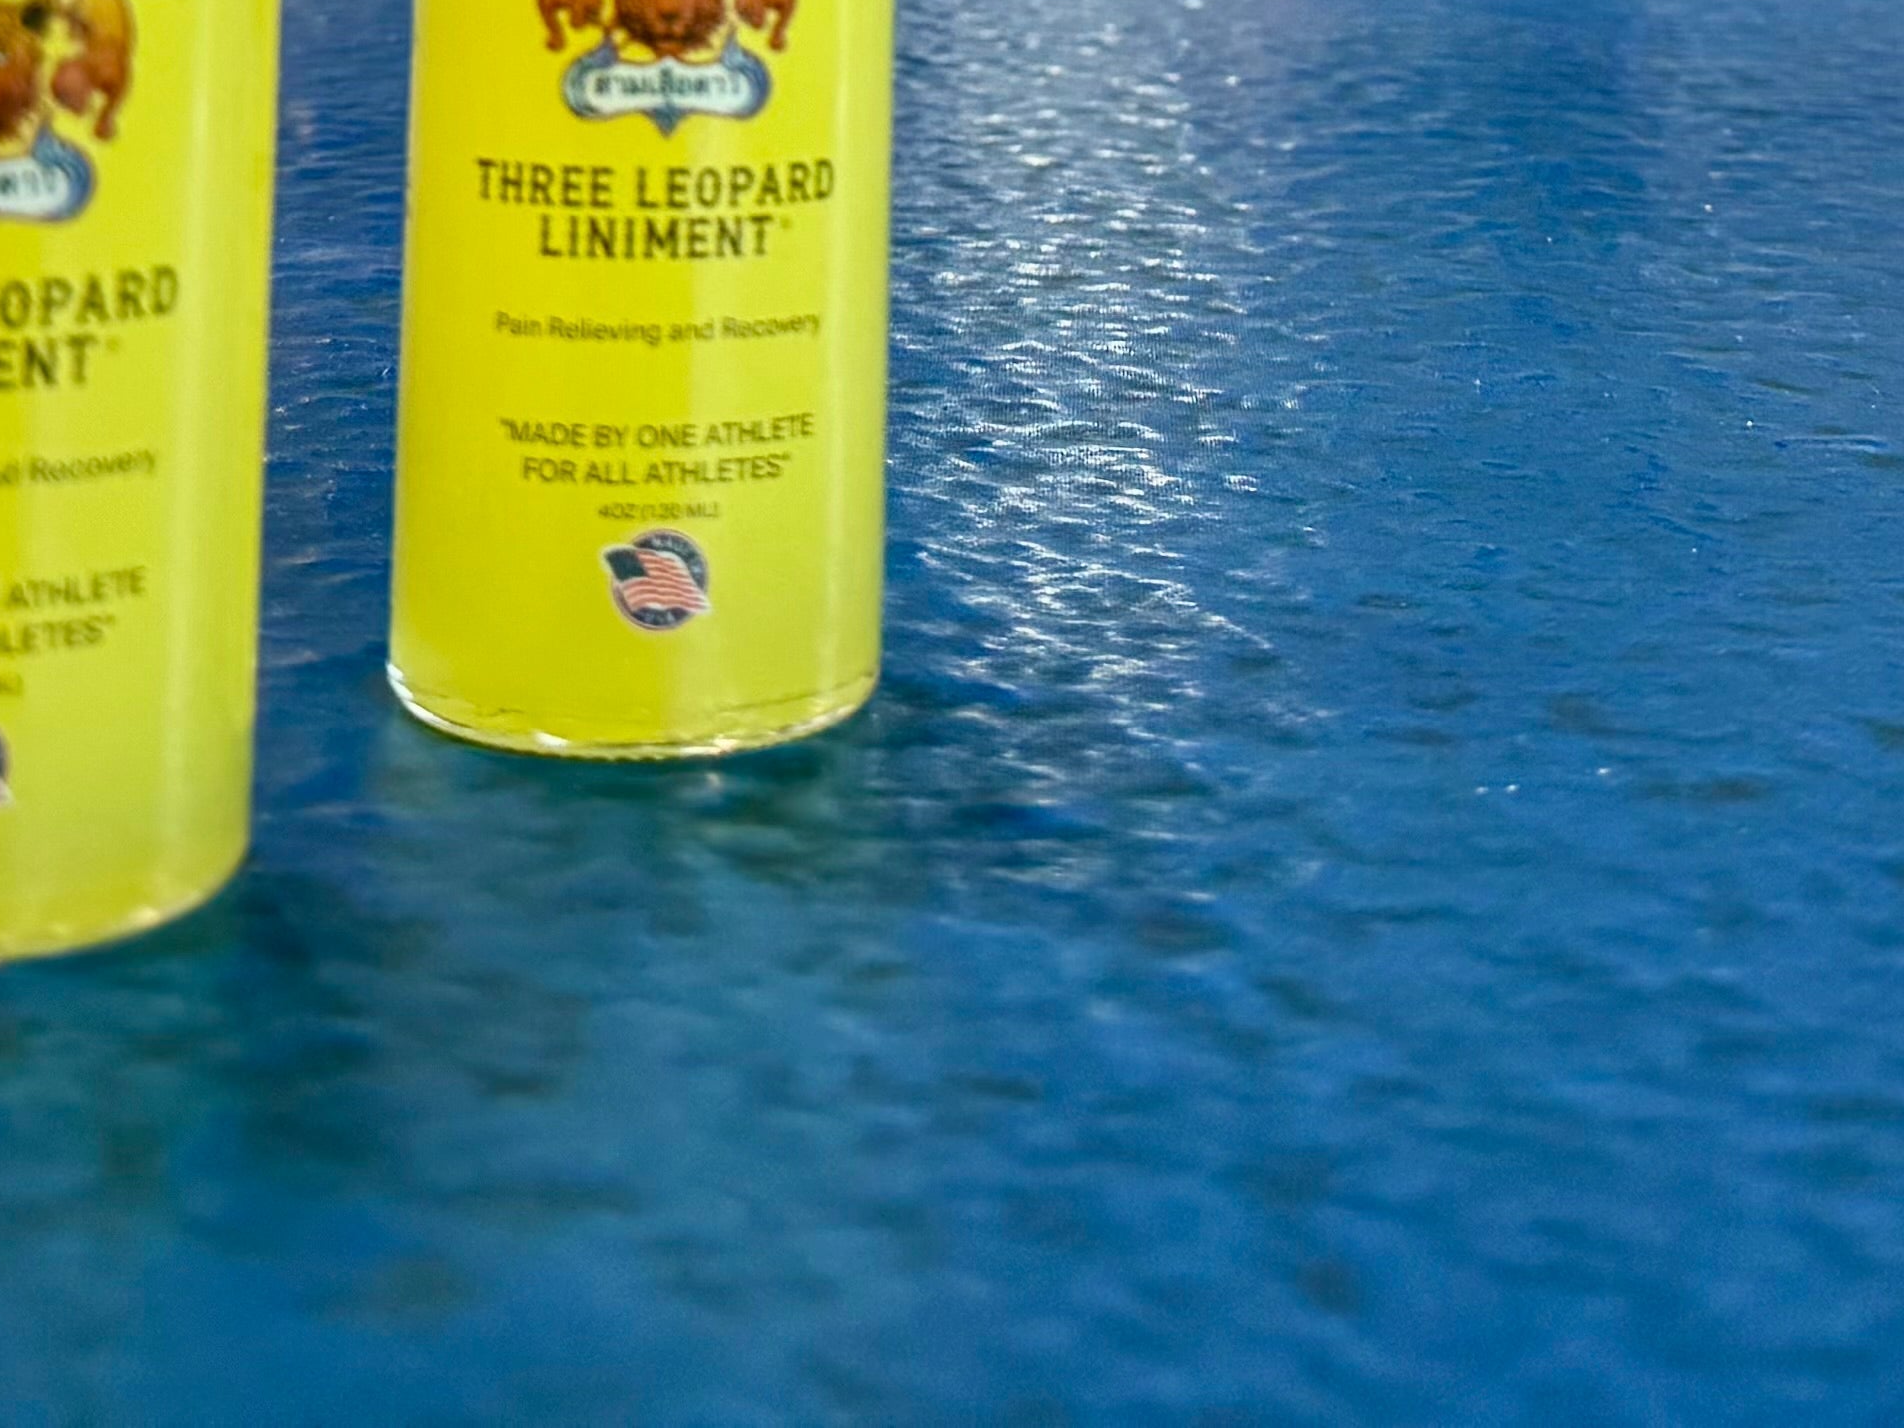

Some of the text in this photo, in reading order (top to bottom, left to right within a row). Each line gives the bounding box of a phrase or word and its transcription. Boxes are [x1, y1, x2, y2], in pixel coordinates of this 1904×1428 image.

[475, 158, 835, 210] THREE LEOPARD
[539, 214, 774, 259] LINIMENT
[670, 318, 714, 341] and
[723, 311, 821, 339] Recovery
[595, 423, 626, 447] BY
[638, 423, 696, 447] ONE
[705, 412, 815, 444] ATHLETE
[30, 448, 157, 484] Recovery
[522, 457, 577, 483] FOR
[584, 460, 637, 485] ALL
[7, 565, 147, 608] ATHLETE
